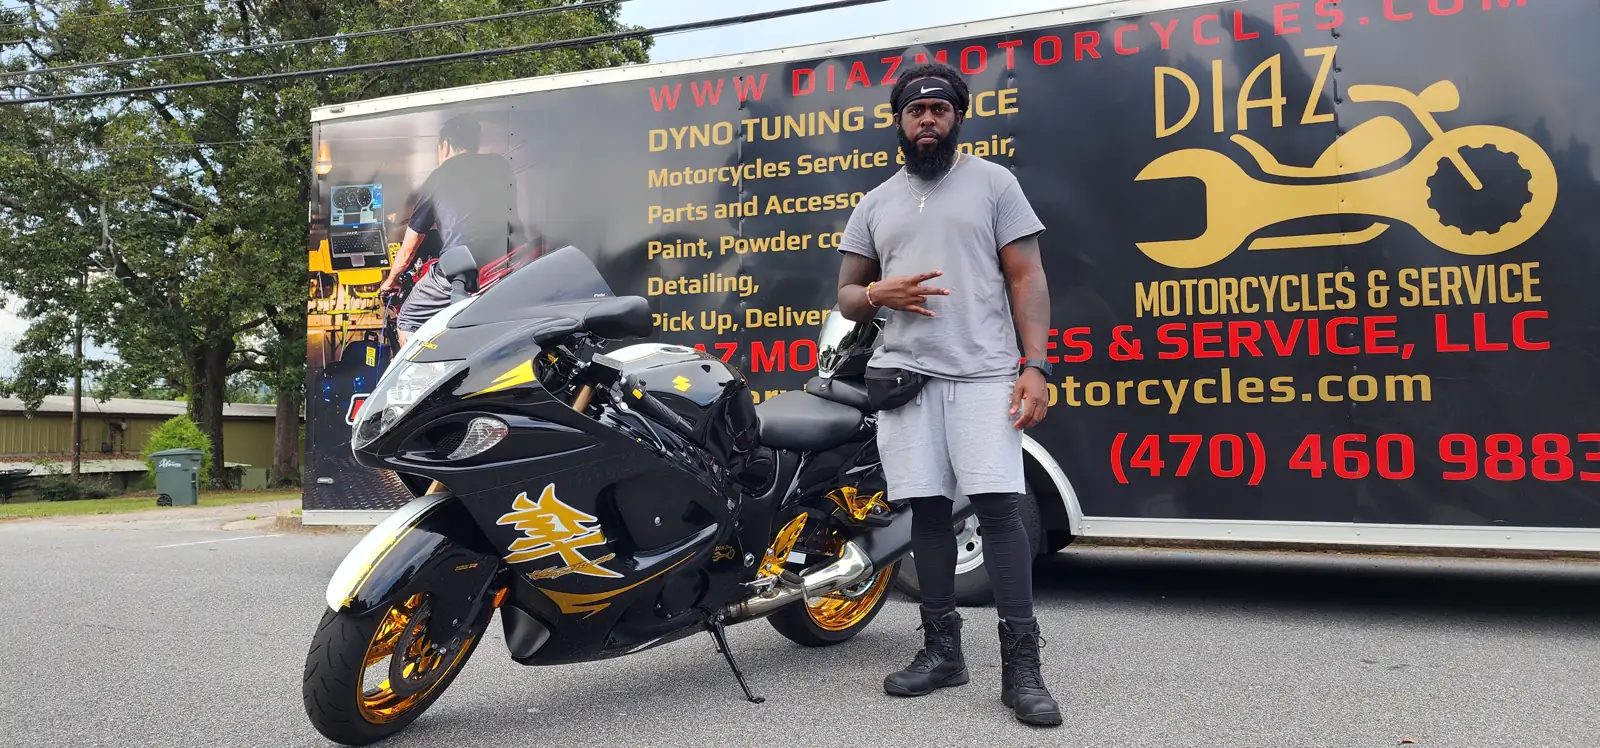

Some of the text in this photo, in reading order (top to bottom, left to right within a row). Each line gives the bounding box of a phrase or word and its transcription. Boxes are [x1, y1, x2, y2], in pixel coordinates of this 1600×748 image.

[648, 73, 768, 112] WWW
[1154, 45, 1338, 139] DIAZ
[649, 121, 733, 152] DYNO
[741, 106, 864, 143] TUNING
[648, 158, 791, 188] Motorcycles
[797, 151, 889, 175] Service
[648, 191, 865, 224] Parts and Accesso
[648, 238, 713, 260] Paint,
[720, 230, 812, 255] Powder
[647, 271, 760, 297] Detailing,
[1134, 262, 1542, 318] MOTORCYCLES & SERVICE
[700, 311, 739, 335] Up,
[1108, 325, 1144, 361] &
[1156, 315, 1415, 361] SERVICE,
[1434, 310, 1550, 354] LLC
[1110, 432, 1600, 485] (470) 460 9883
